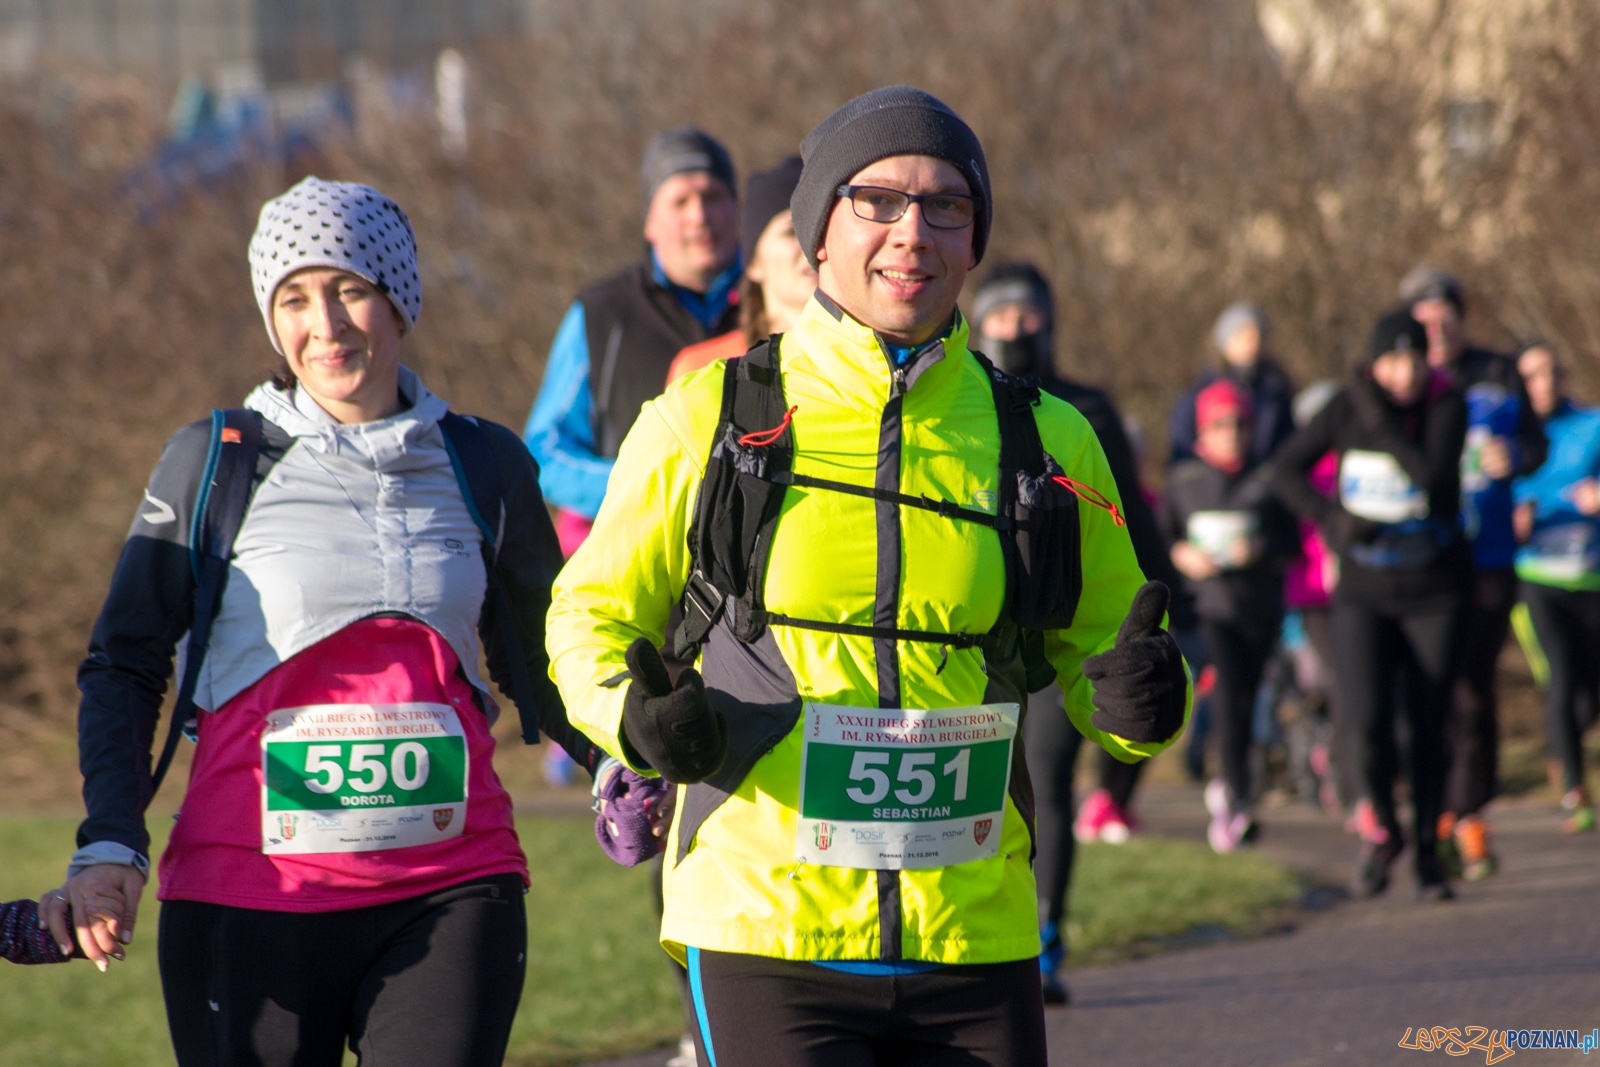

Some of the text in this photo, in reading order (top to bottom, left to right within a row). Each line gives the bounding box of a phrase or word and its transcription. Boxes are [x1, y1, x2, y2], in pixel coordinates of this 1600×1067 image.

[327, 712, 358, 723] BIEG
[359, 710, 447, 723] SYLWESTROWY
[835, 712, 1003, 729] XXXII BIEG SYLWESTROWY
[296, 724, 447, 738] IM. RYSZARDA BURGIELA
[841, 729, 997, 744] IM. RYSZARDA BURGIELA
[303, 741, 431, 795] 550
[845, 747, 971, 806] 551
[340, 794, 395, 806] DOROTA
[872, 805, 951, 819] SEBASTIAN
